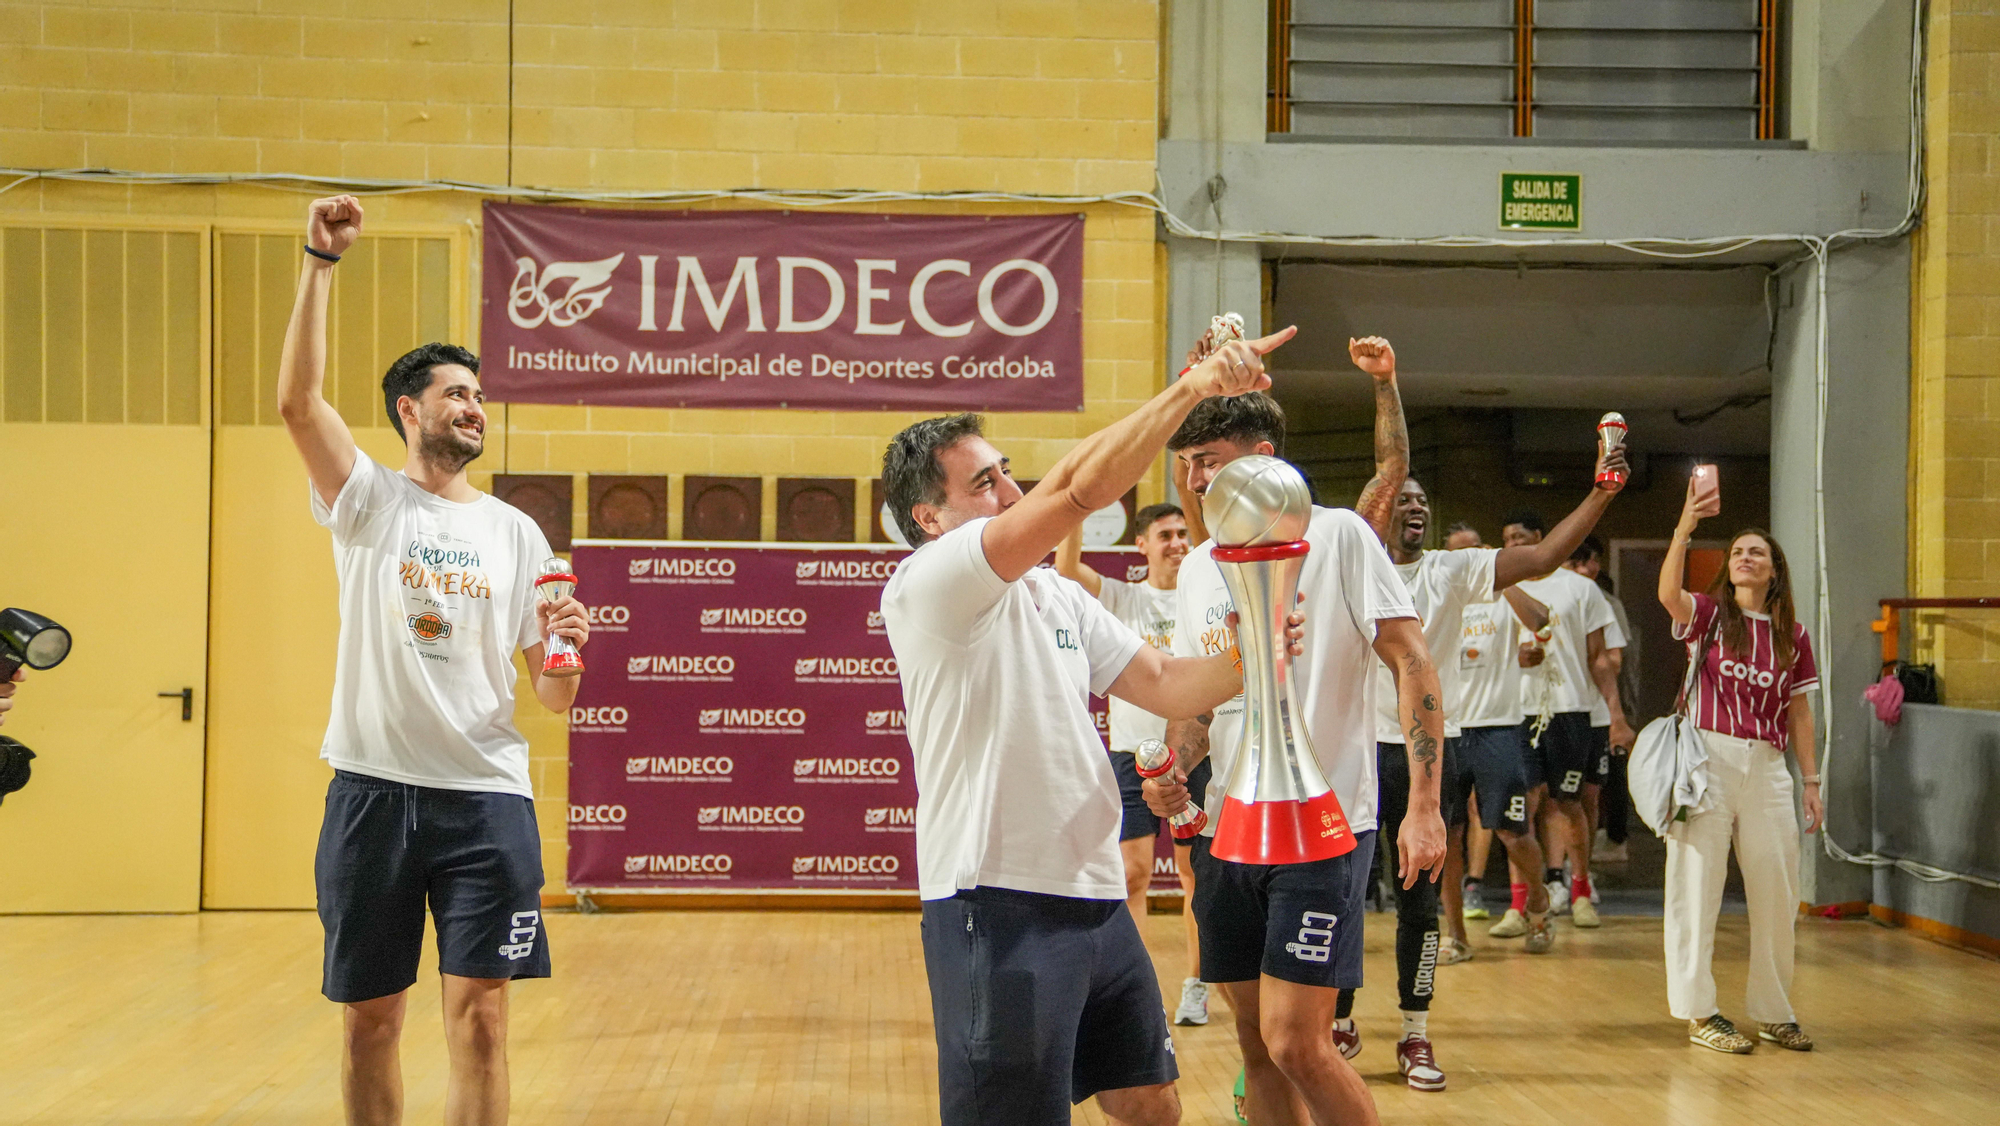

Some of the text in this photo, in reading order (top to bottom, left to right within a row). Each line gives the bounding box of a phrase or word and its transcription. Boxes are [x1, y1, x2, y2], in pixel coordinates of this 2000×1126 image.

[1512, 180, 1568, 200] SALIDA DE
[1505, 202, 1574, 222] EMERGENCIA
[638, 254, 1059, 338] IMDECO
[508, 346, 1056, 384] Instituto Municipal de Deportes Córdoba
[408, 540, 480, 567] CRDOBA
[653, 558, 736, 577] IMDECO
[821, 560, 900, 578] IMDECO
[586, 606, 630, 624] ECO
[725, 608, 807, 626] IMDECO
[652, 656, 735, 674] IMDECO
[820, 658, 899, 676] IMDECO
[1720, 660, 1774, 688] coto
[567, 706, 629, 725] DECO
[723, 708, 806, 727] IMDECO
[651, 756, 734, 775] IMDECO
[818, 758, 900, 776] IMDECO
[566, 804, 627, 823] DECO
[722, 806, 805, 824] IMDECO
[649, 854, 732, 873] IMDECO
[817, 856, 899, 874] IMDECO
[506, 910, 539, 960] CCB
[1298, 911, 1338, 962] CCB
[1413, 931, 1439, 996] CORDOBA
